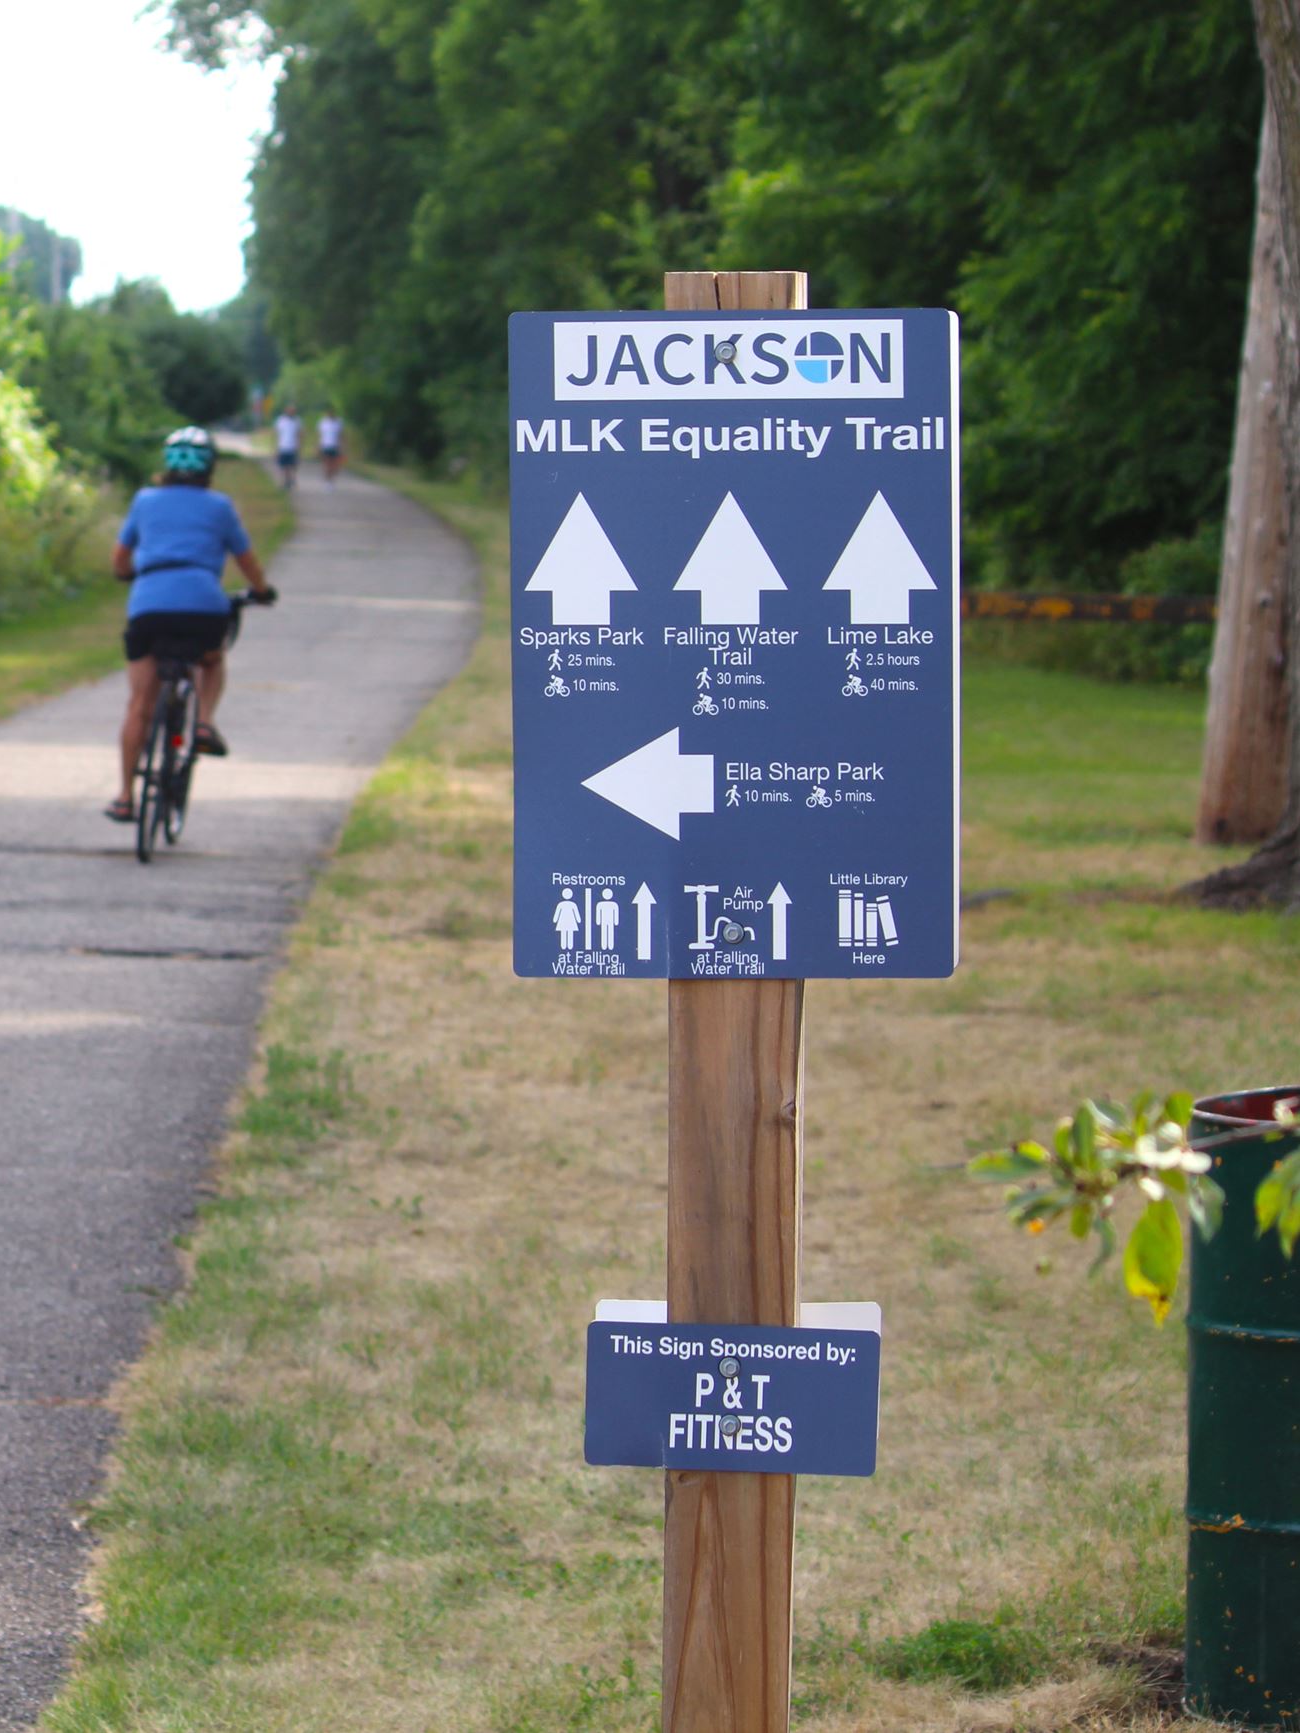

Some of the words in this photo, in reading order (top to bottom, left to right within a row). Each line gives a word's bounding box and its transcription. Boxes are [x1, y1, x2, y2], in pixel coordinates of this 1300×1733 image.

[566, 331, 891, 387] JACKSON
[516, 418, 625, 452] MLK
[641, 417, 831, 459] Equality
[845, 417, 945, 450] Trail
[520, 628, 591, 649] Sparks
[599, 628, 644, 646] Park
[664, 627, 730, 650] Falling
[736, 628, 799, 646] Water
[827, 628, 878, 645] Lime
[884, 628, 934, 645] Lake
[568, 654, 582, 667] 25
[585, 654, 616, 667] mins.
[709, 647, 753, 666] Trail
[866, 653, 885, 666] 2.5
[888, 653, 920, 666] hours
[573, 679, 587, 692] 10
[590, 679, 620, 692] mins.
[717, 672, 731, 685] 30
[734, 672, 765, 685] mins.
[870, 678, 885, 691] 40
[888, 678, 919, 691] mins.
[722, 697, 736, 710] 10
[739, 697, 769, 710] mins.
[725, 762, 762, 781] Ella
[769, 762, 830, 784] Sharp
[837, 763, 884, 780] Park
[745, 790, 758, 802] 10
[761, 790, 792, 802] mins.
[835, 790, 842, 802] 5
[845, 790, 876, 802] mins.
[553, 873, 626, 885] Restrooms
[830, 873, 861, 885] Little
[864, 873, 908, 888] Library
[734, 887, 753, 899] Air
[723, 898, 764, 913] Pump
[558, 953, 570, 964] at
[575, 952, 619, 967] Falling
[697, 953, 709, 964] at
[717, 952, 759, 967] Falling
[853, 952, 886, 964] Here
[552, 963, 592, 975] Water
[595, 963, 626, 975] Trail
[691, 963, 731, 975] Water
[734, 963, 765, 975] Trail
[610, 1334, 652, 1354] This
[659, 1336, 704, 1360] Sign
[710, 1339, 820, 1361] Sponsored
[826, 1343, 856, 1365] by:
[695, 1372, 714, 1407] P
[723, 1376, 743, 1409] &
[752, 1375, 770, 1409] T
